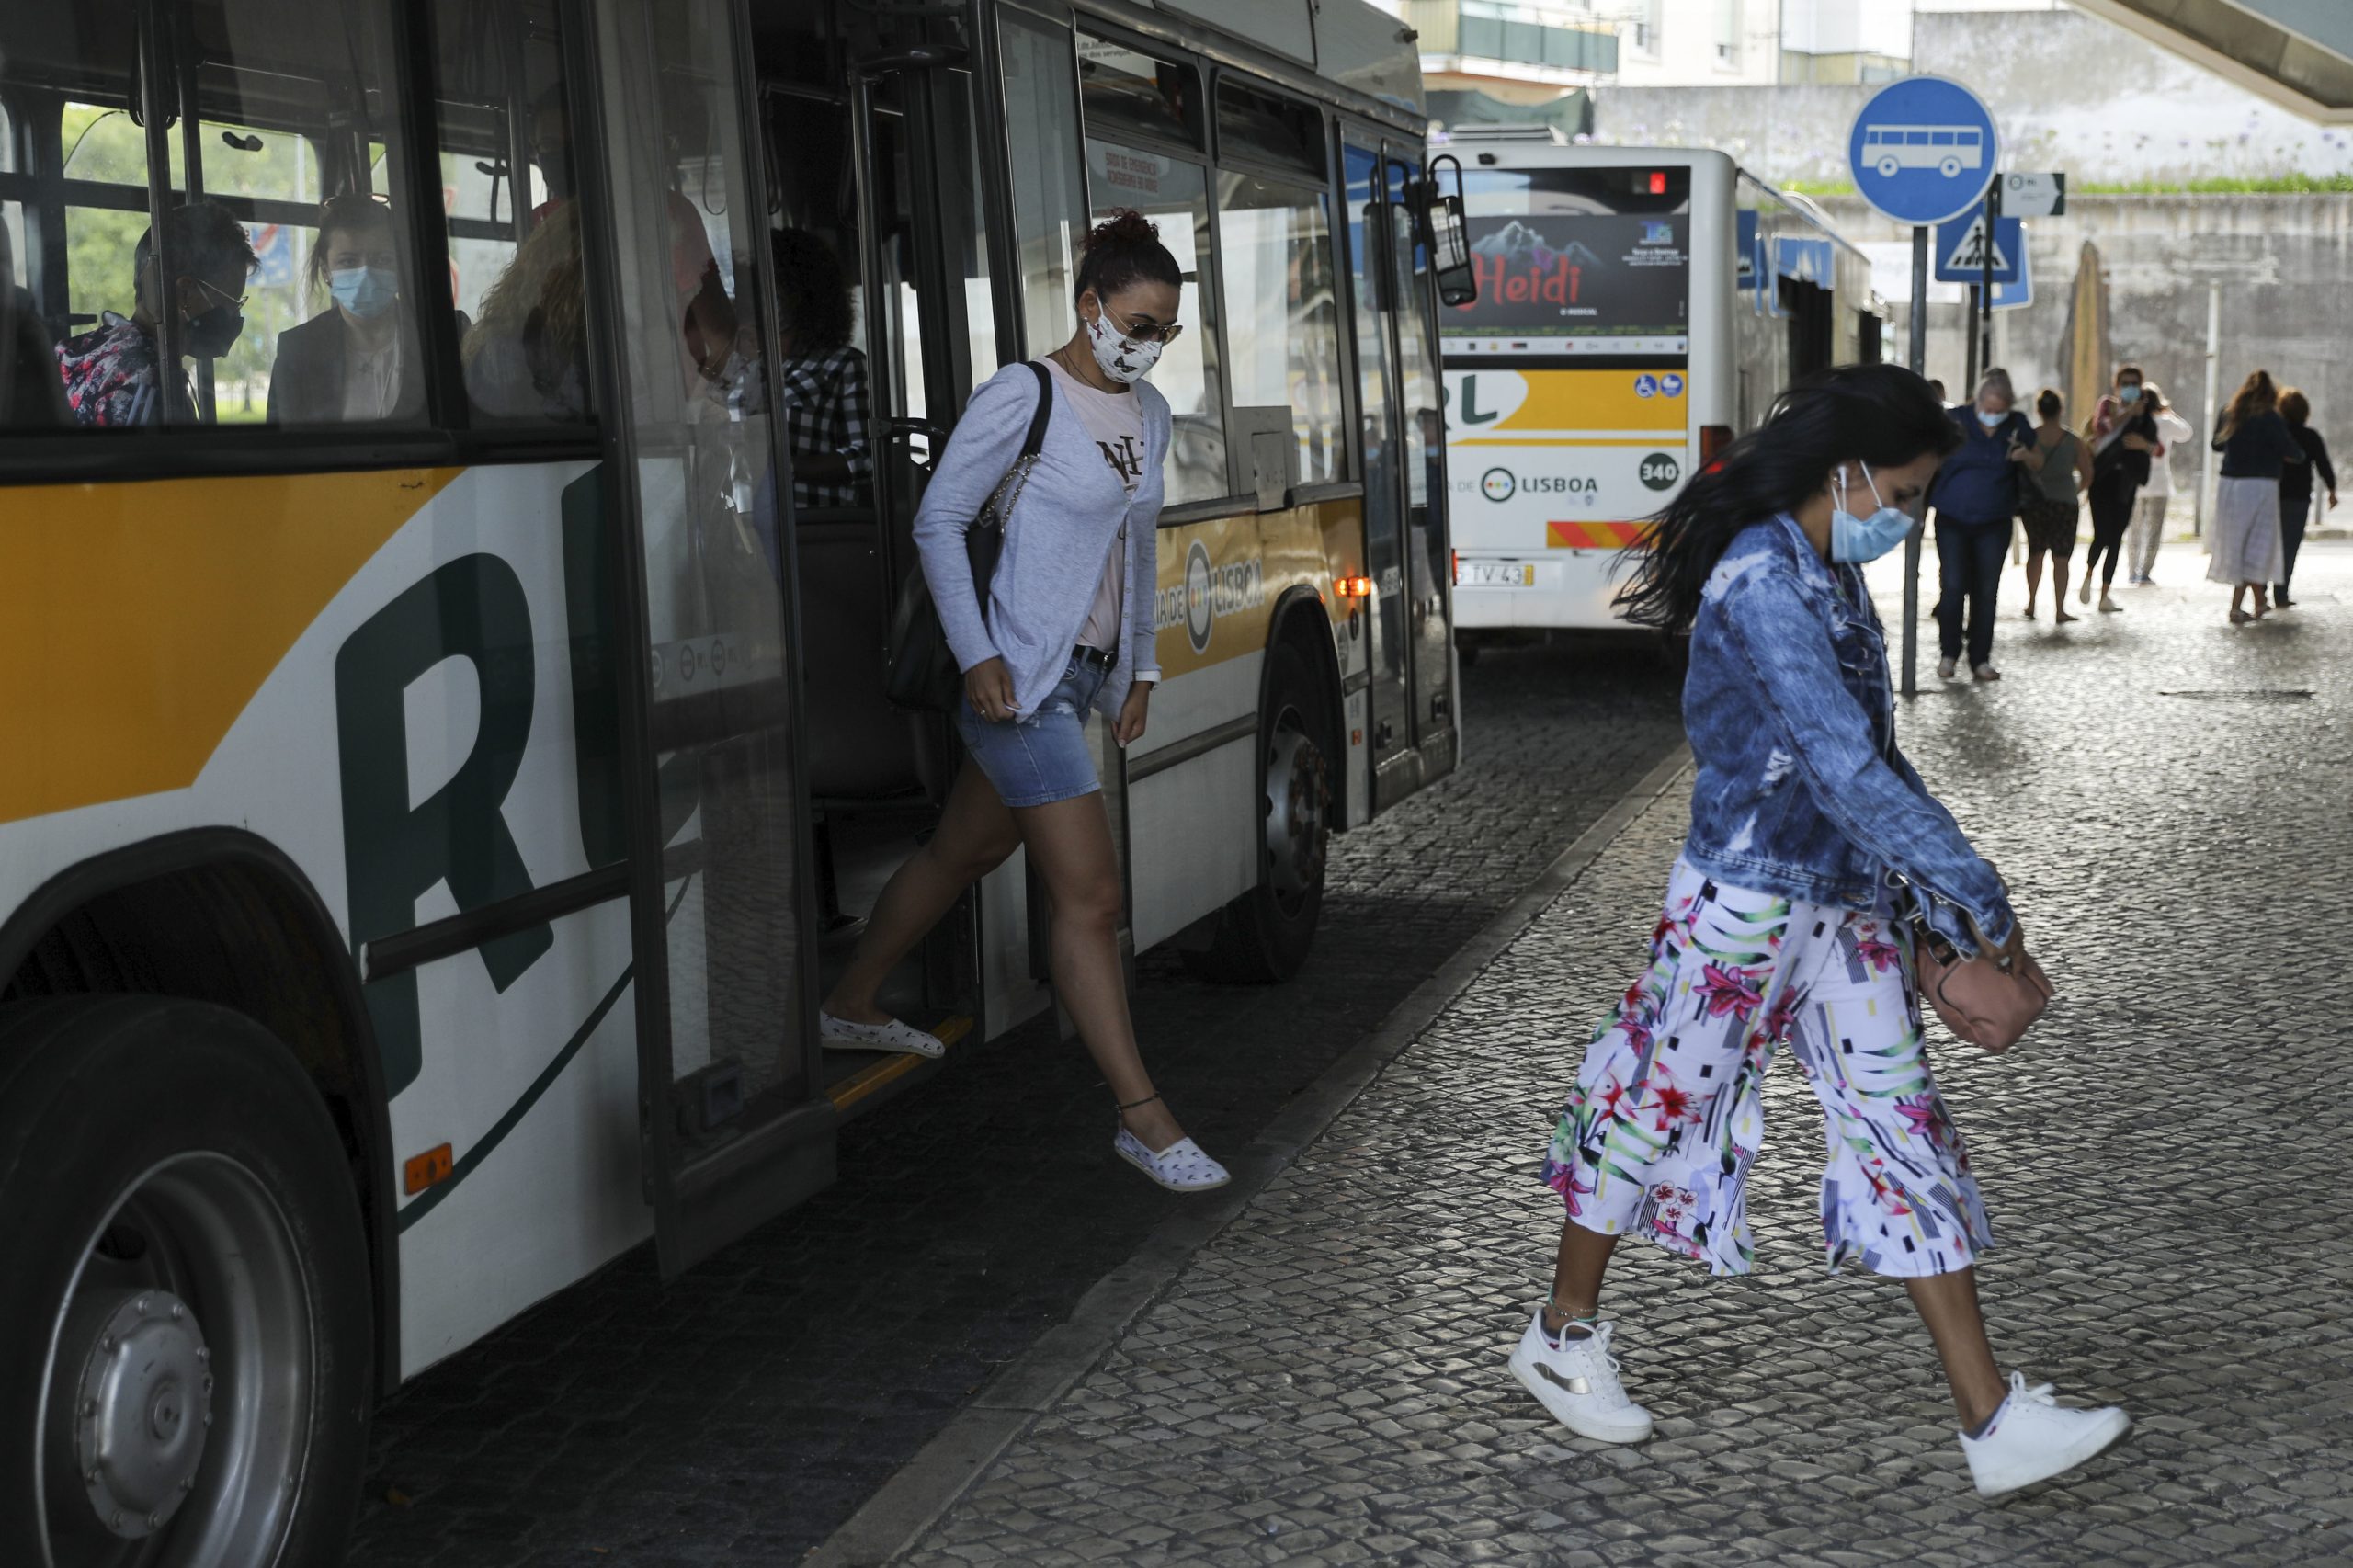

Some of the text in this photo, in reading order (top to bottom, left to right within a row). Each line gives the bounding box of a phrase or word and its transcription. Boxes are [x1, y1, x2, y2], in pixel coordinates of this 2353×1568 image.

[1456, 251, 1581, 312] Heidi
[1522, 478, 1597, 493] LISBOA
[1642, 463, 1677, 481] 340
[1169, 589, 1183, 621] DE
[1214, 562, 1262, 613] LISBOA
